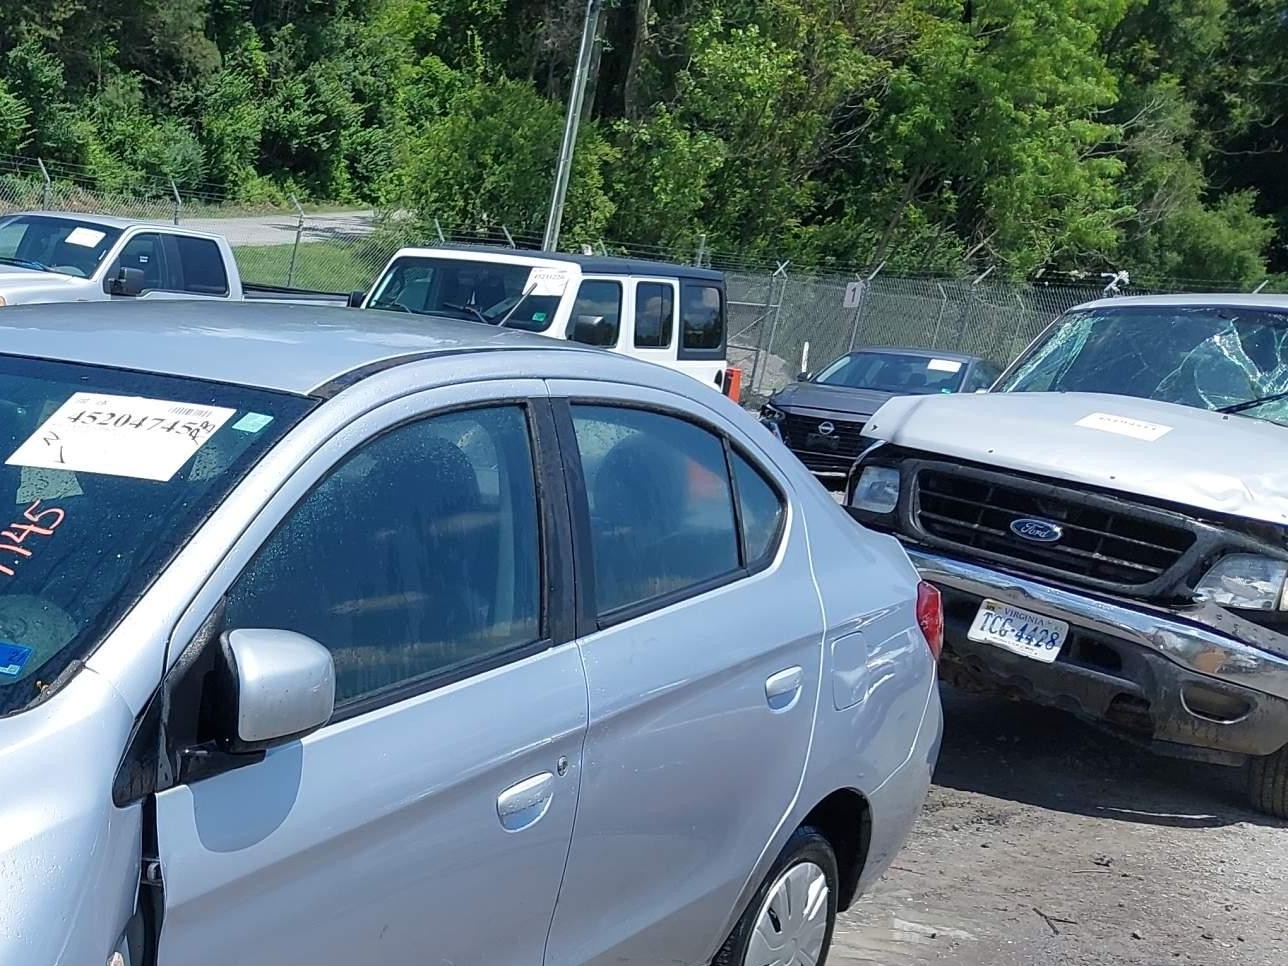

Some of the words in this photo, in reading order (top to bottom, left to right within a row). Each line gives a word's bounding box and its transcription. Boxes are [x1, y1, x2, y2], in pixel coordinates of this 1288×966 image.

[851, 287, 857, 303] 1
[68, 410, 197, 435] 45204745
[1004, 608, 1045, 626] VIRGINIA
[979, 612, 1060, 650] TCG-4428
